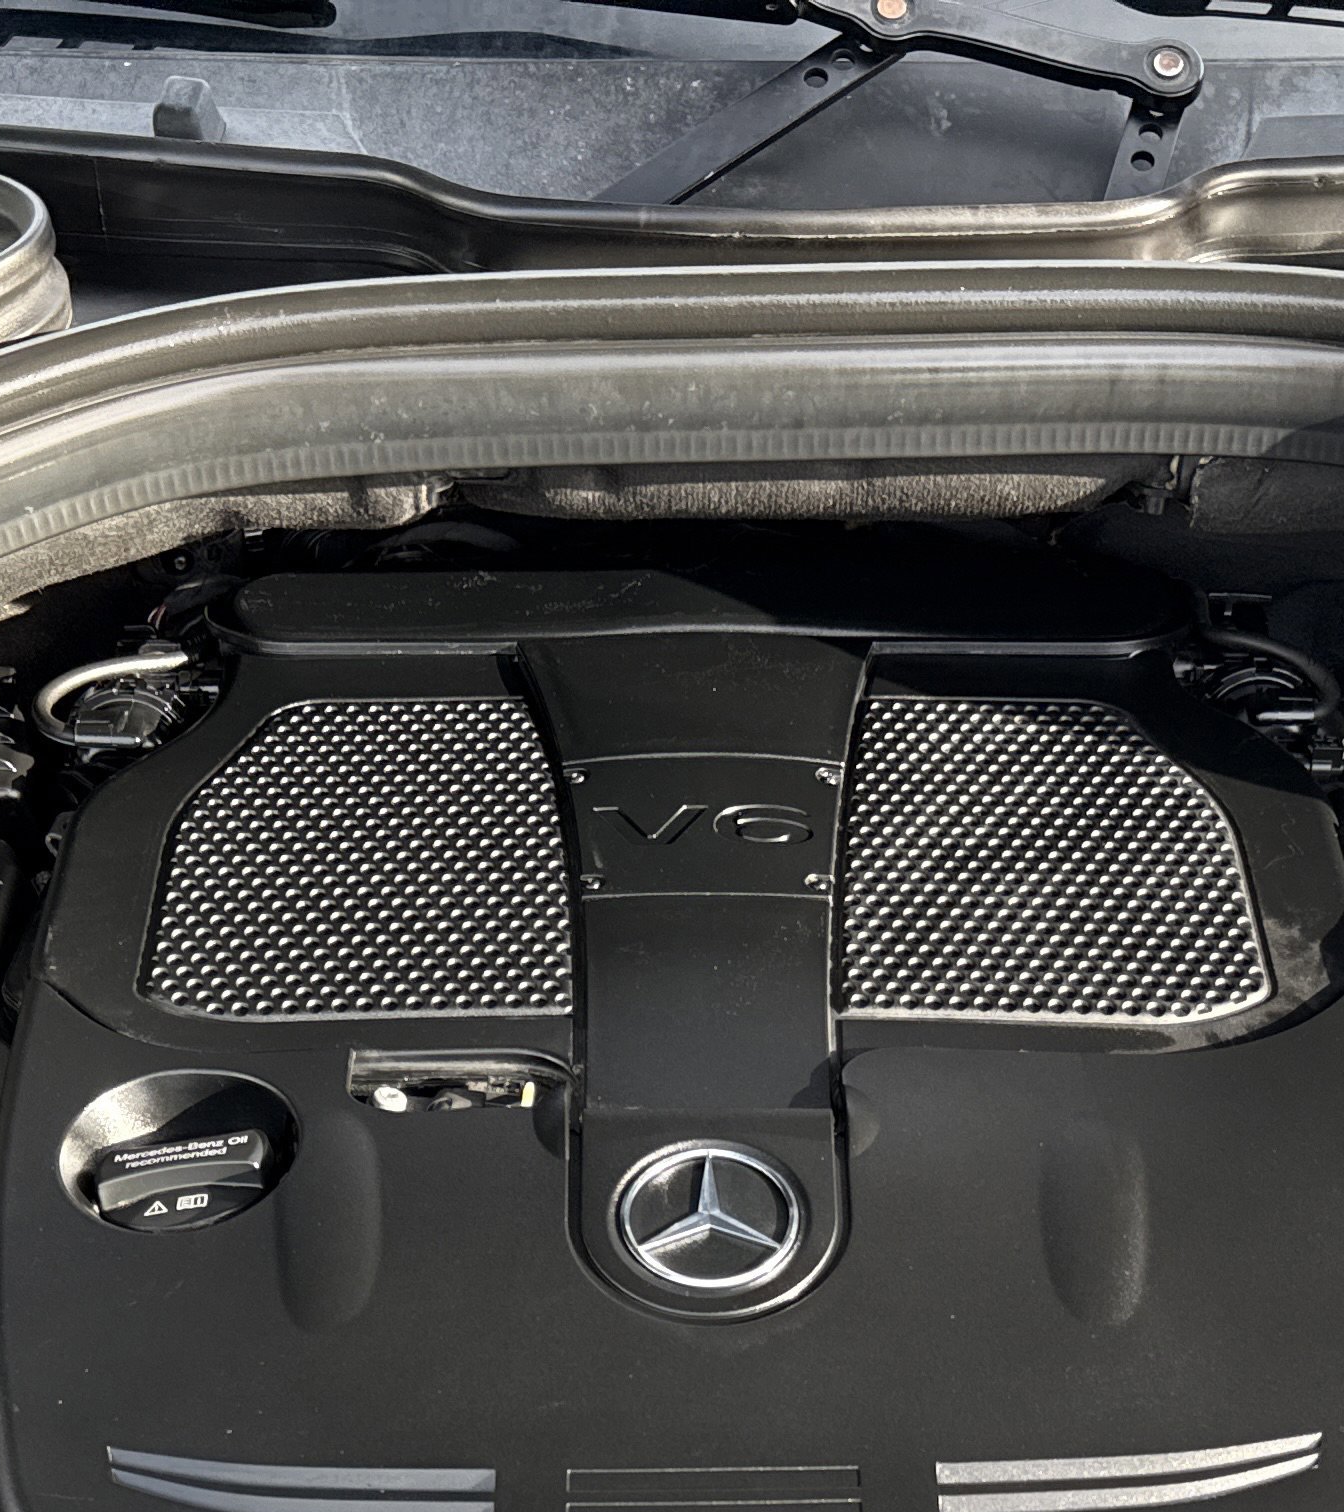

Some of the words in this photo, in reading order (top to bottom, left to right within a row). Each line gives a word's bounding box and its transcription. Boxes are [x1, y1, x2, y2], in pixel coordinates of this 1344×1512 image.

[592, 804, 814, 845] V6
[114, 1140, 225, 1163] Mercedes-Benz
[125, 1147, 228, 1169] recommended
